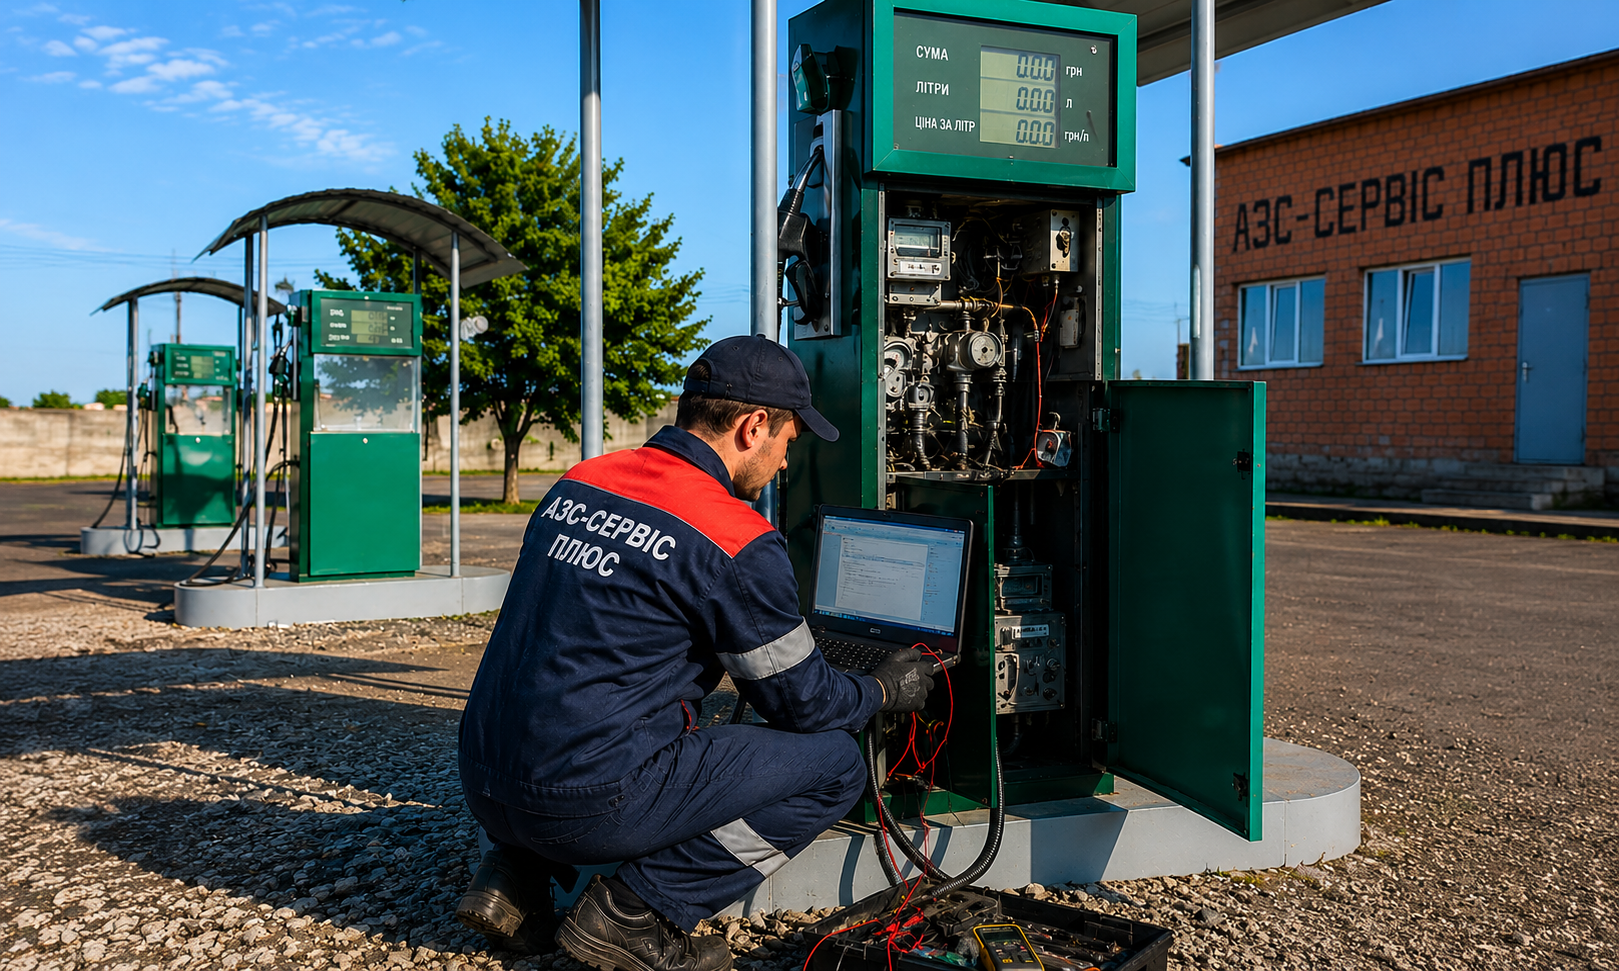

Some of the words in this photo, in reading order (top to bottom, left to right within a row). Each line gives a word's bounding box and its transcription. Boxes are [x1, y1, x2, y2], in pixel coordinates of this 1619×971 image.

[916, 45, 949, 61] СУМА
[1066, 66, 1083, 78] грн
[915, 81, 949, 96] ЛІТРИ
[1065, 98, 1073, 109] л
[915, 116, 938, 130] ЦІНА
[940, 118, 952, 131] ЗА
[954, 119, 976, 133] ЛІТР
[1233, 166, 1445, 252] АЗС-СЕРВІС
[1467, 135, 1602, 214] ПЛЮС
[540, 496, 677, 561] АЗС-СЕРВІС
[547, 533, 620, 577] ПЛЮС
